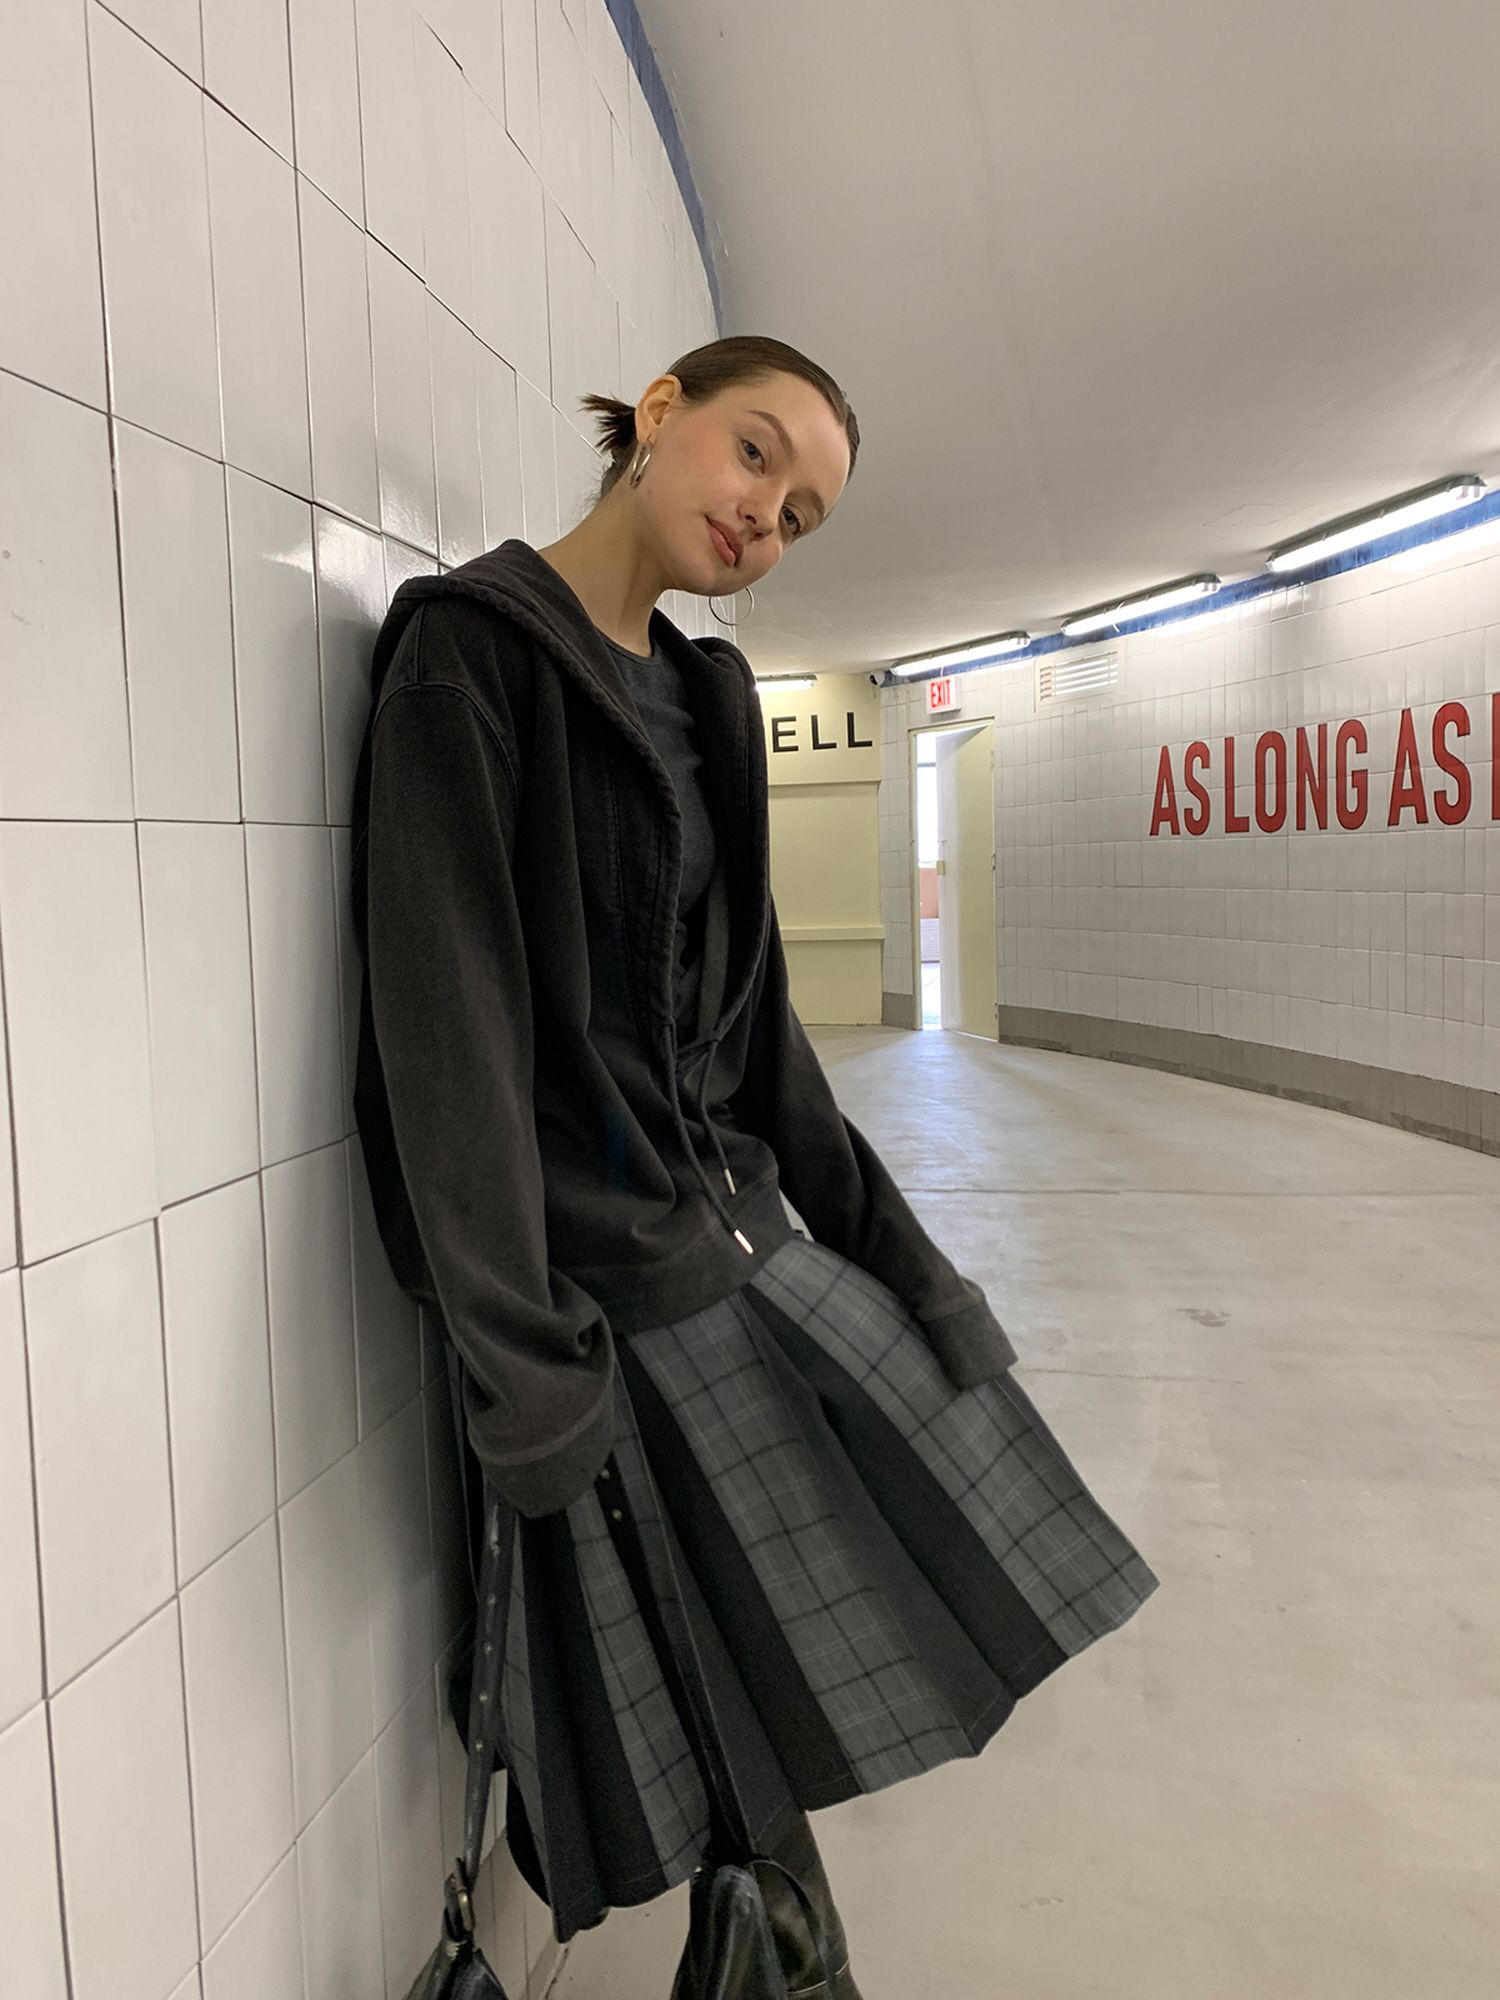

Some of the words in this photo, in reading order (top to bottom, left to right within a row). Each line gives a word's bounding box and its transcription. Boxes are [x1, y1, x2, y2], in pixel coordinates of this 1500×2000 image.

[930, 679, 951, 709] EXIT
[771, 711, 873, 753] ELL
[1149, 741, 1211, 836] AS
[1224, 719, 1369, 832] LONG
[1387, 702, 1472, 826] AS
